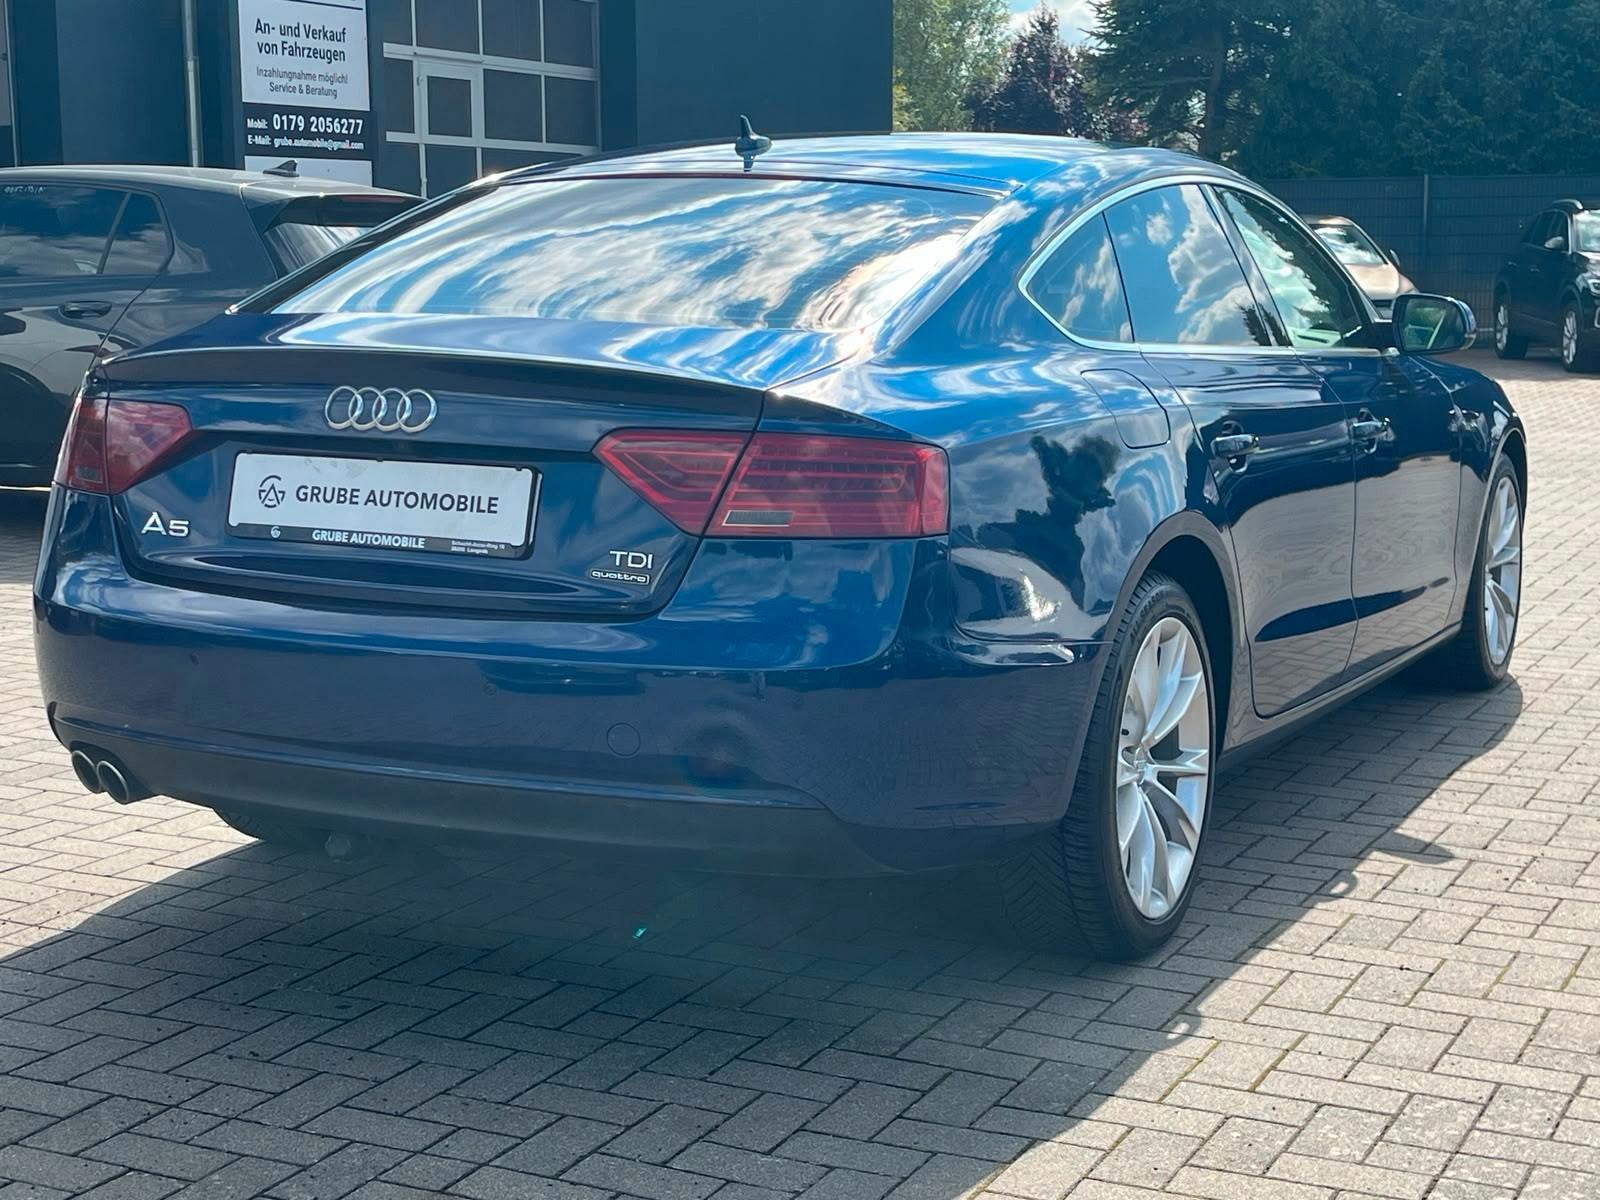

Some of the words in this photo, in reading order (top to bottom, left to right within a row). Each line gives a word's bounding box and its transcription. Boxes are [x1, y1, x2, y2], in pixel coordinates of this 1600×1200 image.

[255, 18, 276, 35] An-
[279, 22, 300, 38] und
[303, 24, 347, 43] Verkauf
[257, 41, 278, 55] von
[281, 41, 346, 64] Fahrzeugen
[256, 66, 317, 81] Inzahlungnahme
[269, 81, 297, 94] Service
[298, 84, 304, 95] &
[305, 84, 338, 99] Beratung
[247, 118, 268, 129] Mobil:
[272, 113, 305, 131] 0179
[310, 116, 363, 135] 2056277
[295, 485, 361, 505] GRUBE
[363, 489, 499, 514] AUTOMOBILE
[141, 511, 190, 537] A5
[312, 529, 349, 543] GRUBE
[349, 532, 425, 549] AUTOMOBILE
[609, 550, 653, 569] TDI
[591, 570, 647, 583] quattro
